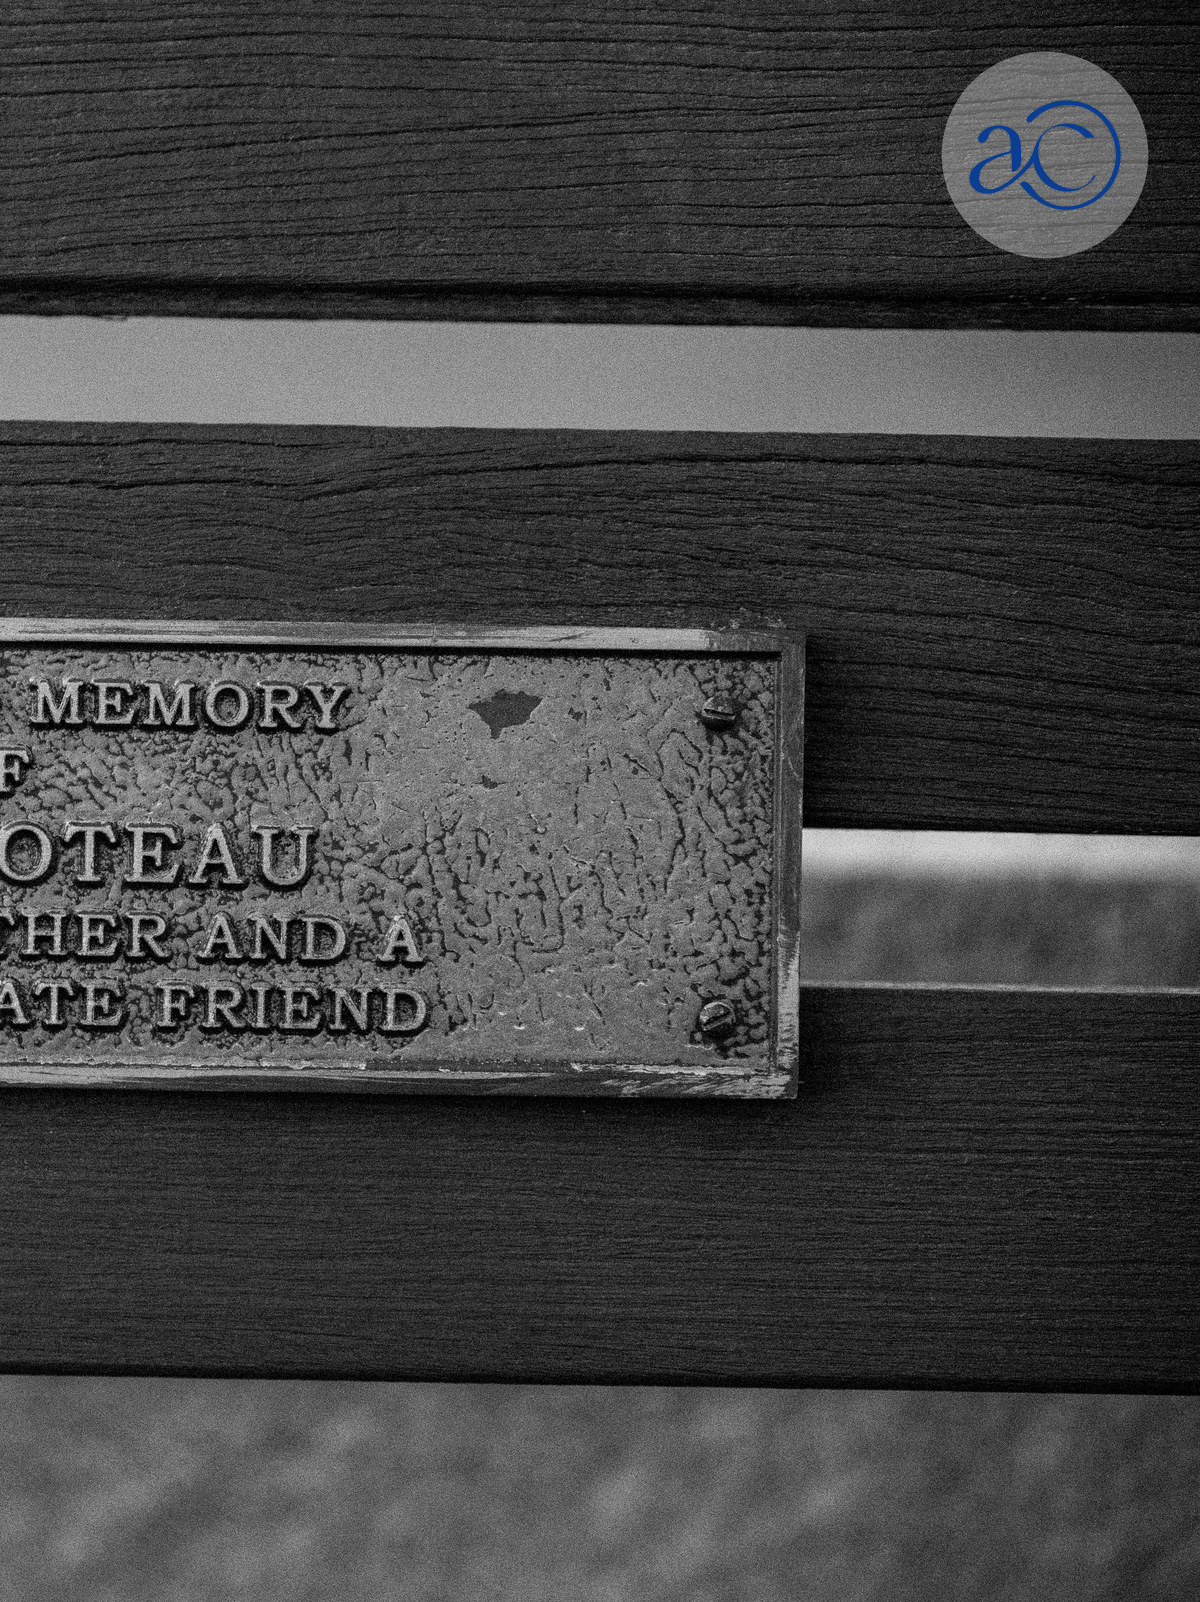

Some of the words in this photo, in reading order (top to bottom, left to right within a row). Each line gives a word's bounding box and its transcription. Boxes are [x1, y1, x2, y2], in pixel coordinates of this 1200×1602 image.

[29, 677, 350, 730] MEMORY
[201, 913, 347, 962] AND
[376, 914, 425, 965] A
[155, 979, 428, 1034] FRIEND
